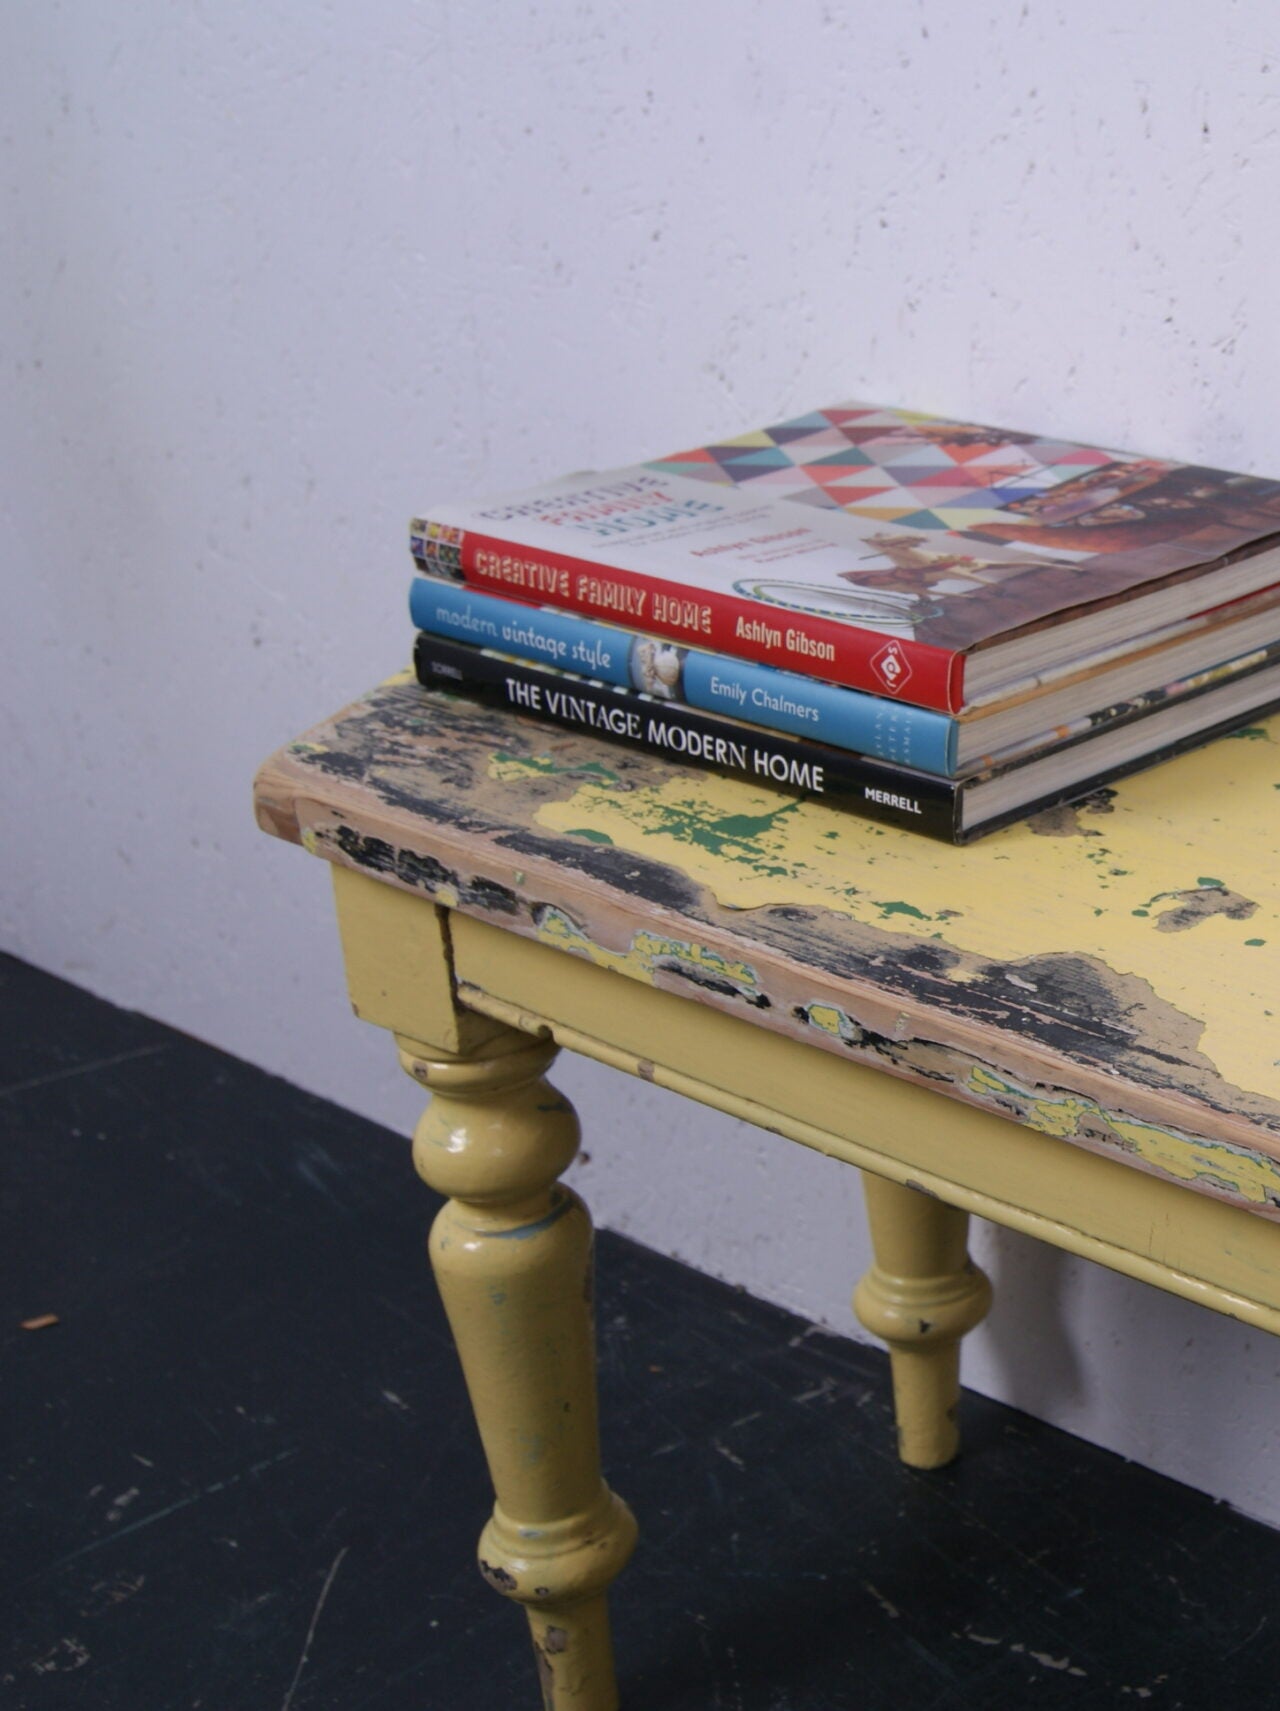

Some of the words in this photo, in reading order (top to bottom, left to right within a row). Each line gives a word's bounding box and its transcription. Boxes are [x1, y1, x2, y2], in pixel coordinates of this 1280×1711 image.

[474, 550, 570, 598] CREATIVE
[577, 575, 647, 617] FAMILY
[653, 593, 713, 635] HOME
[436, 604, 498, 638] modern
[502, 620, 567, 660] vintage
[571, 640, 612, 671] style
[736, 616, 782, 649] Ashlyn
[786, 629, 836, 662] Gibson
[710, 675, 748, 707] Emily
[752, 687, 820, 723] Chalmers
[506, 678, 541, 711] THE
[545, 689, 642, 740] VINTAGE
[648, 718, 747, 770] MODERN
[754, 750, 825, 793] HOME
[865, 786, 922, 815] MERRELL
